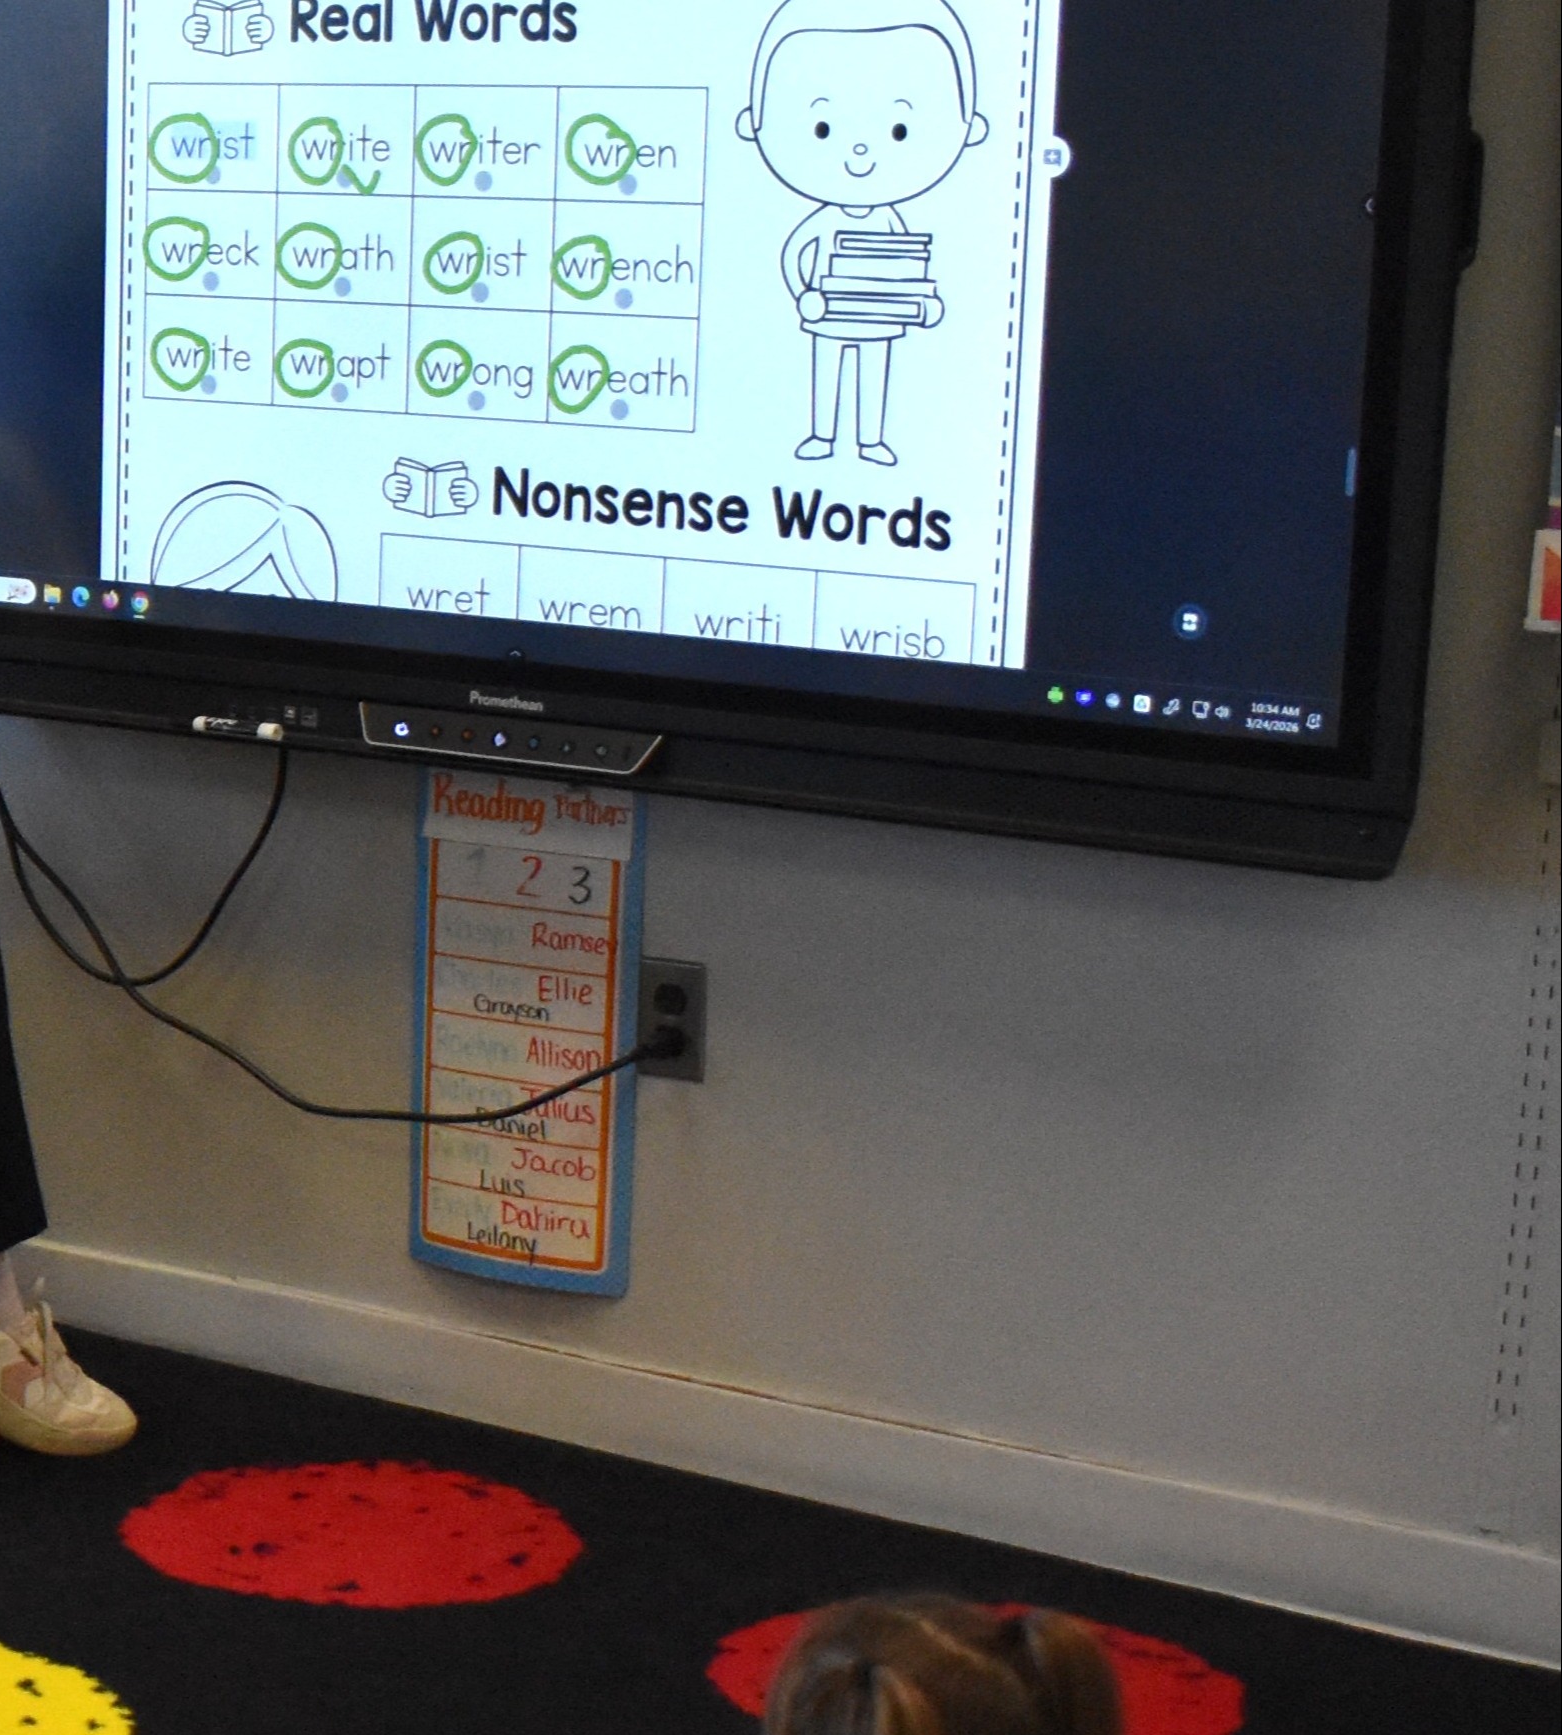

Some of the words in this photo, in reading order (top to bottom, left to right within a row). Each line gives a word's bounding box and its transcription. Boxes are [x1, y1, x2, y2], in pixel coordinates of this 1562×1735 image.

[290, 0, 394, 43] Real
[416, 0, 579, 43] Words
[171, 123, 256, 161] wrist
[300, 124, 391, 162] write
[430, 126, 541, 165] writer
[583, 139, 677, 170] wren
[161, 230, 259, 267] wreck
[292, 234, 394, 272] wrath
[437, 239, 527, 278] wrist
[560, 244, 693, 283] wrench
[166, 334, 251, 372] write
[290, 342, 391, 389] wrapt
[424, 358, 533, 401] wrong
[553, 357, 690, 396] wreath
[493, 466, 750, 534] Nonsense
[773, 486, 953, 551] Words
[407, 578, 491, 616] wret
[539, 597, 642, 630] wrem
[840, 620, 945, 659] wrisb
[469, 690, 545, 713] Promethean
[1281, 705, 1301, 717] AM
[432, 771, 547, 836] Reading
[515, 855, 543, 899] 2
[567, 866, 592, 905] 3
[538, 974, 594, 1006] Ellie
[526, 1036, 602, 1073] Allison
[479, 1169, 526, 1198] Luis
[511, 1147, 597, 1182] Jacob
